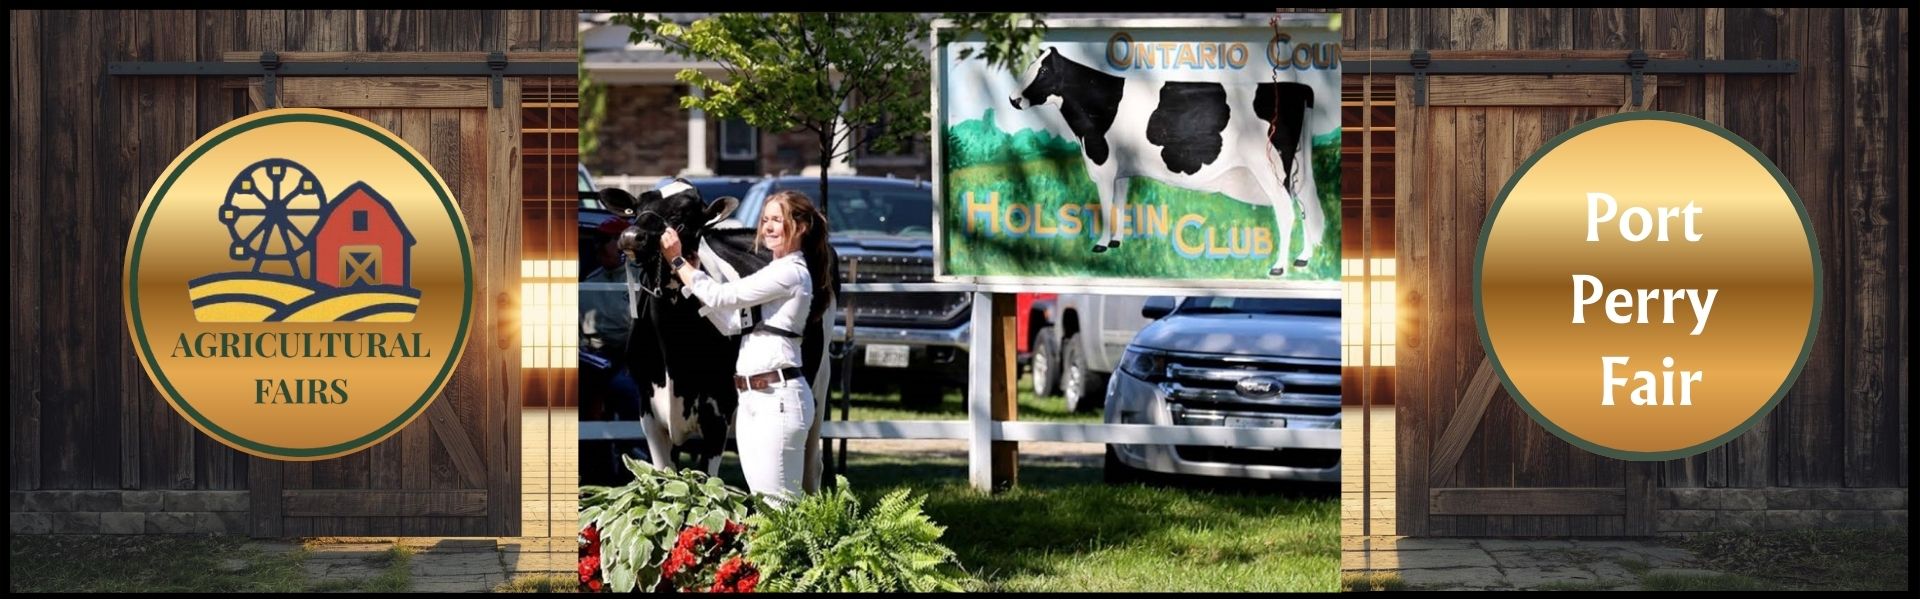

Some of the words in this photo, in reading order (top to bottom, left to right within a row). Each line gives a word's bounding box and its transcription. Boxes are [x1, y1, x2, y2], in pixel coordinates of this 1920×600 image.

[1106, 32, 1249, 71] ONTARIO
[964, 191, 1169, 239] HOLSTEIN
[1173, 213, 1273, 259] CLUB
